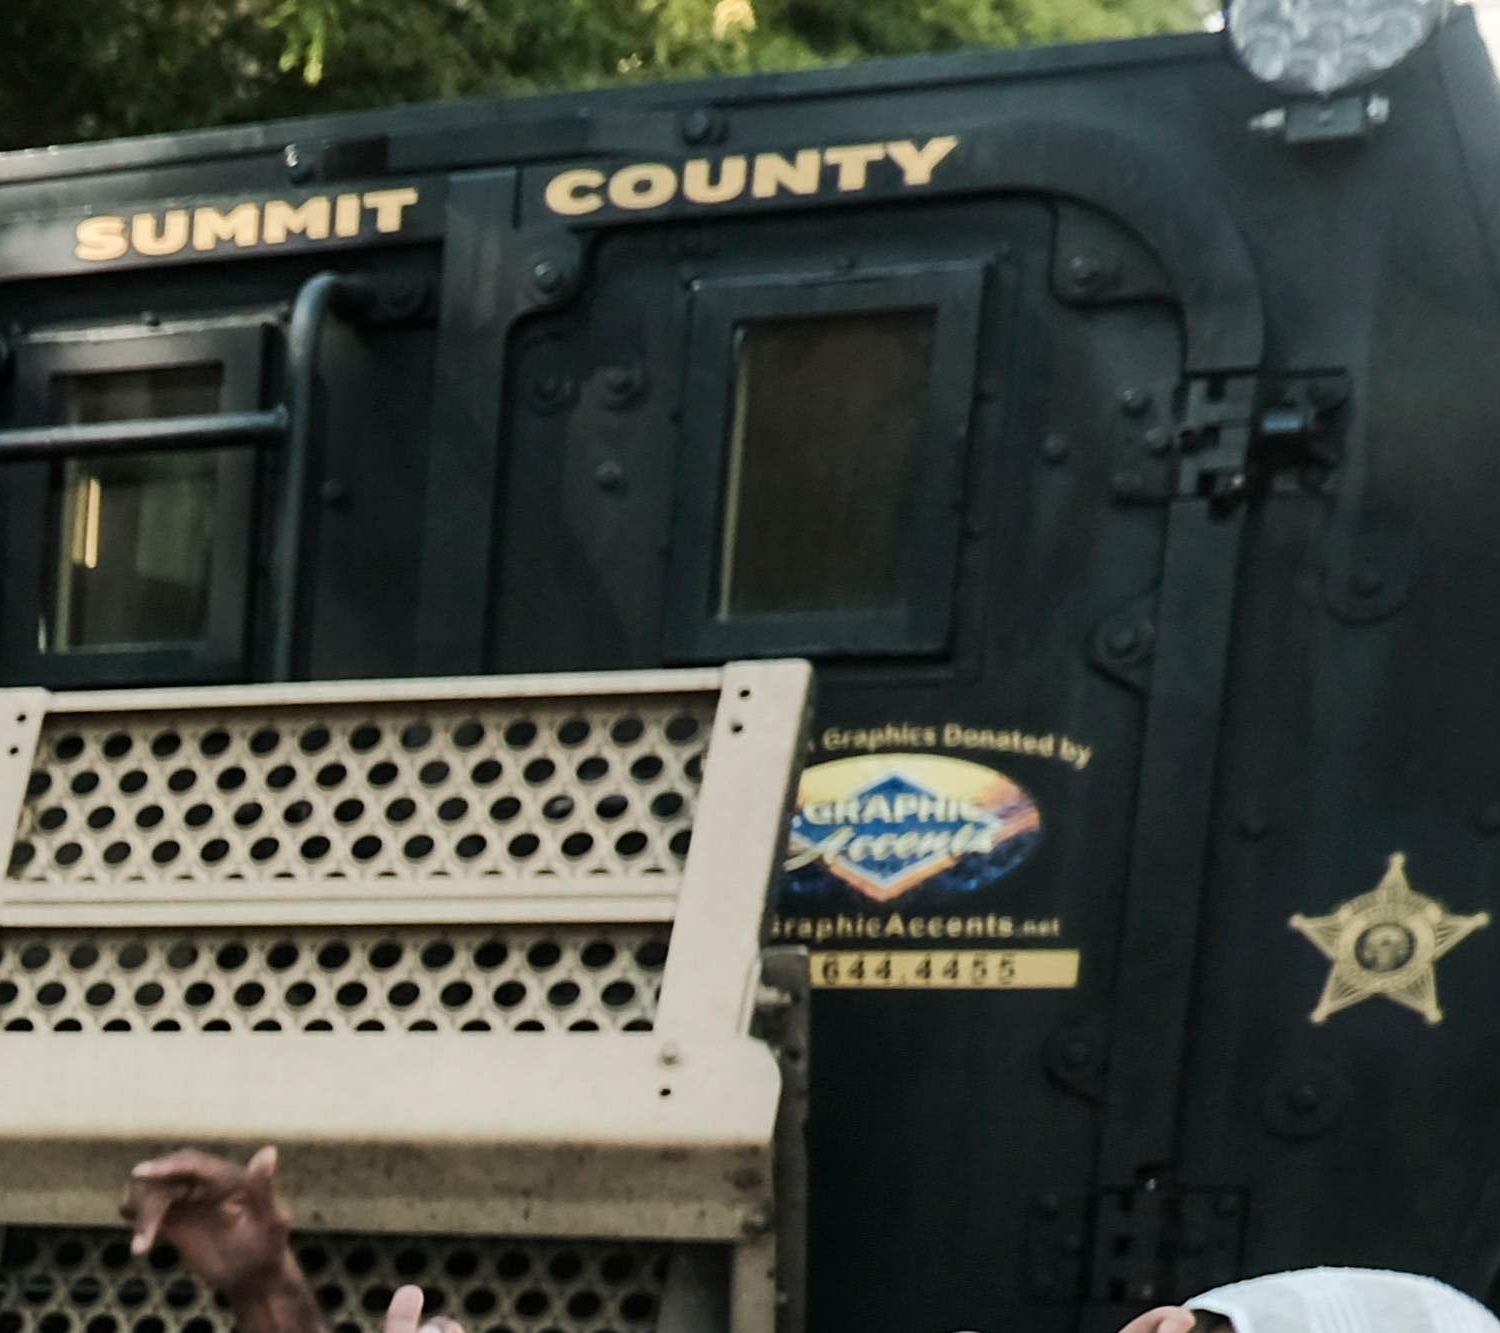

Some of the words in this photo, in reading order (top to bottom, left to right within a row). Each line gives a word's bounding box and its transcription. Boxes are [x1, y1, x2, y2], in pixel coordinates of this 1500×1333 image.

[74, 187, 419, 262] SUMMIT
[544, 135, 959, 217] COUNTY
[822, 722, 938, 752] Graphics
[944, 722, 1055, 758] Donated
[1060, 735, 1091, 770] by
